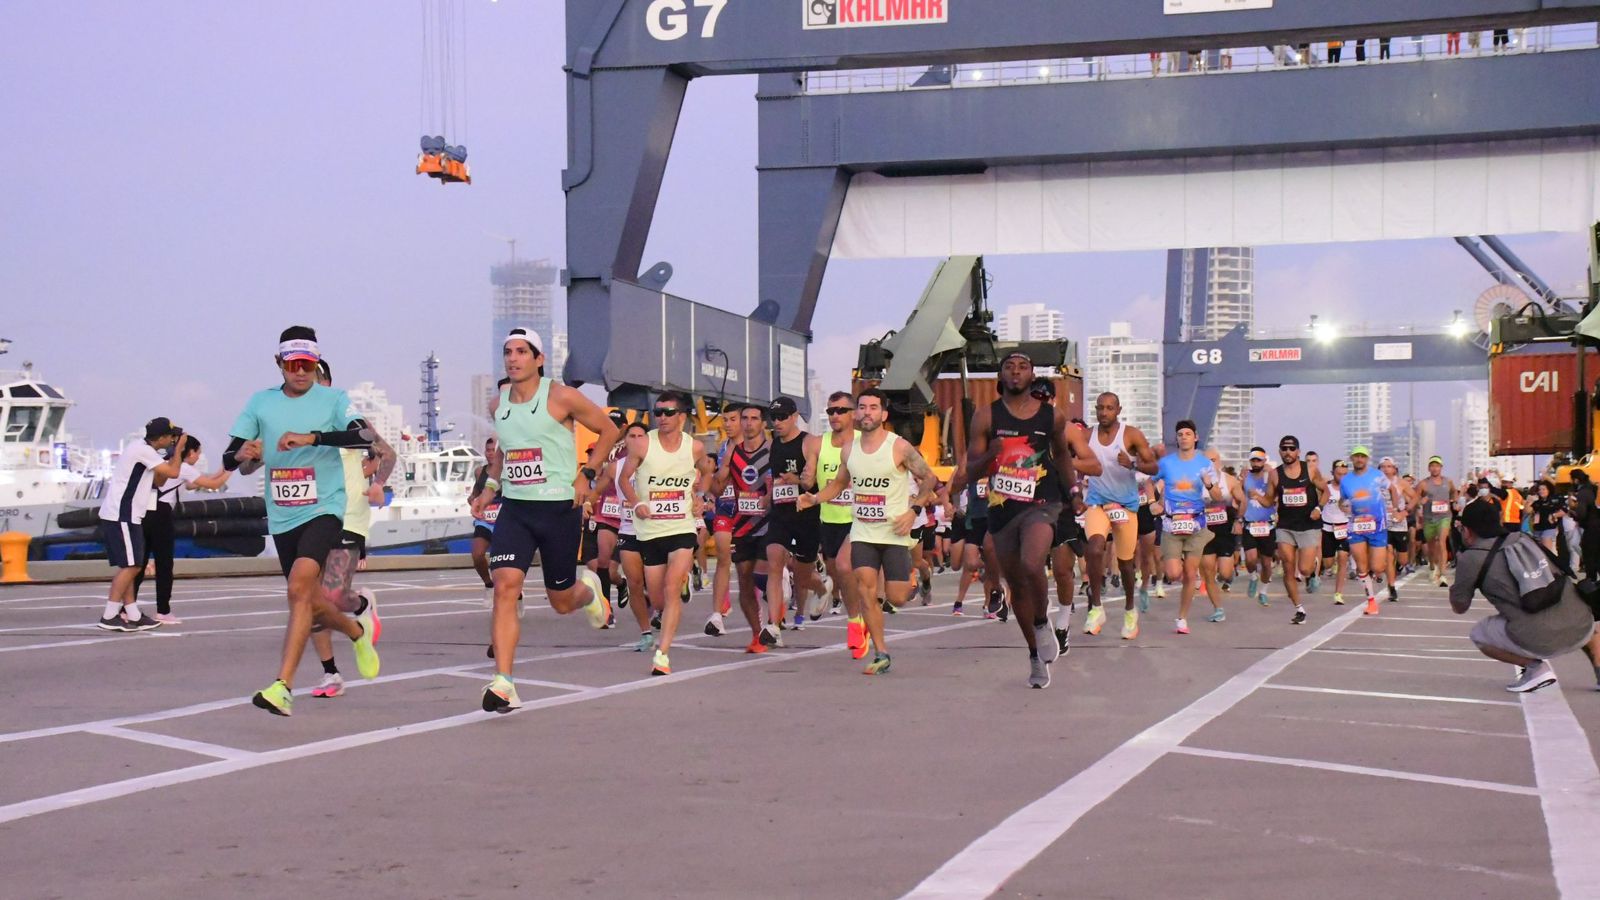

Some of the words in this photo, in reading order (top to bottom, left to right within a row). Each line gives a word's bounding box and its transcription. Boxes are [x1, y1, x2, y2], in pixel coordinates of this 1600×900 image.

[839, 0, 943, 23] KALMAR
[646, 0, 727, 41] G7
[1192, 348, 1222, 365] G8
[1262, 349, 1299, 360] KALMAR
[1519, 370, 1559, 393] CAI
[507, 464, 543, 479] 3004
[276, 484, 310, 498] 1627
[775, 487, 794, 498] 646
[996, 478, 1033, 495] 3954
[656, 502, 680, 513] 245
[856, 506, 884, 517] 4235
[1207, 513, 1225, 522] 3216
[1172, 522, 1194, 530] 2230
[489, 553, 516, 563] FOCUS
